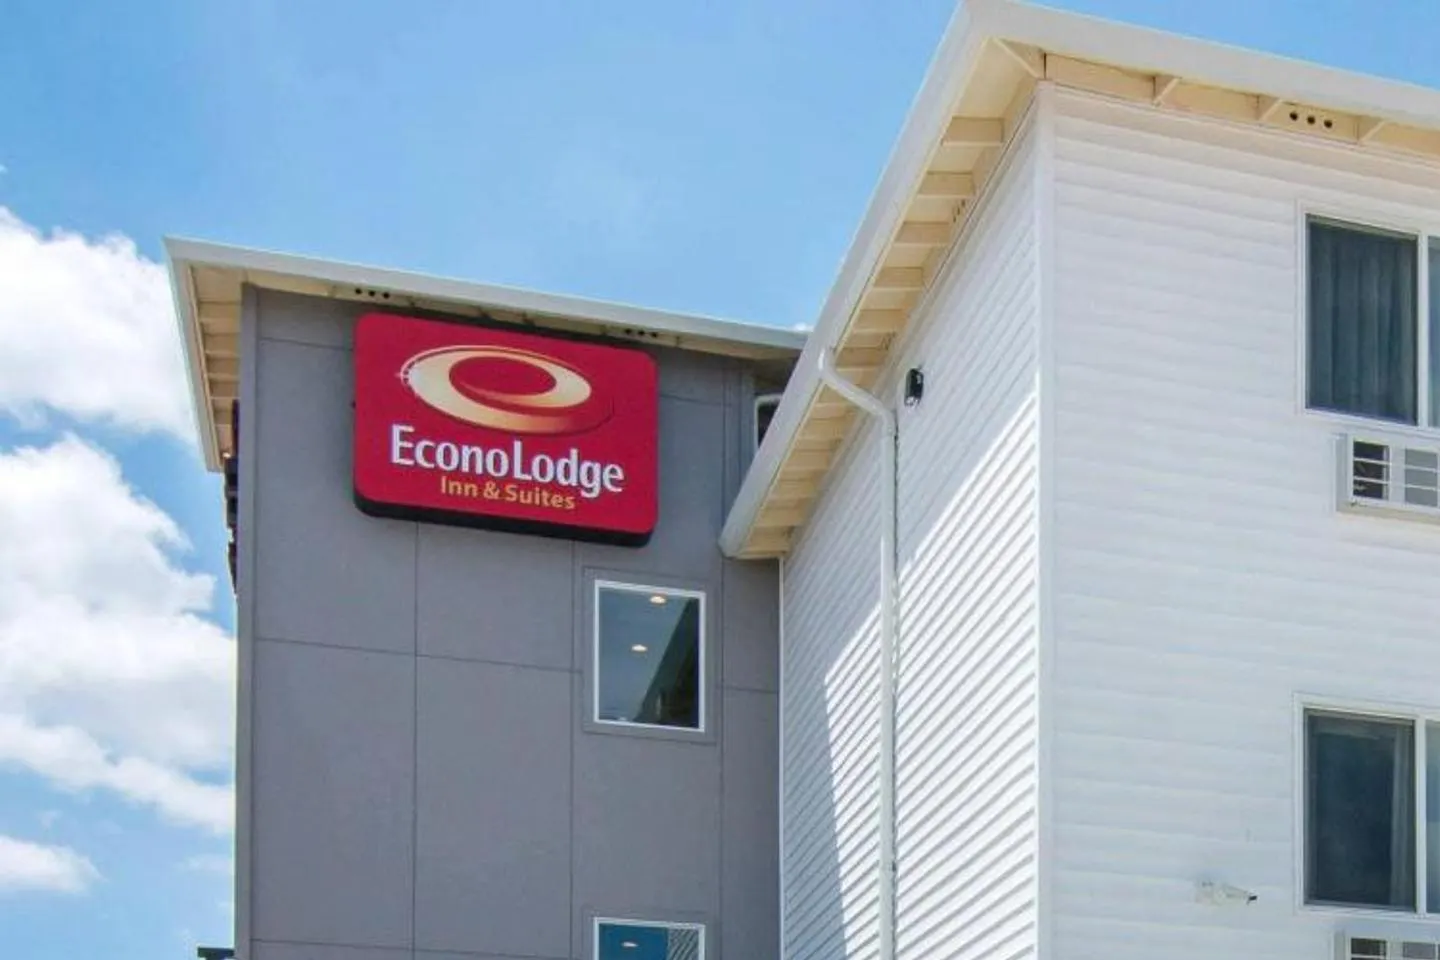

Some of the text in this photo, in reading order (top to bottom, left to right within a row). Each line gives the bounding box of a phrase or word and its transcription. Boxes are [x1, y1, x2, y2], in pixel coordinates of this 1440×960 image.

[390, 424, 624, 499] EconoLodge
[441, 476, 576, 510] Inn & Suites
